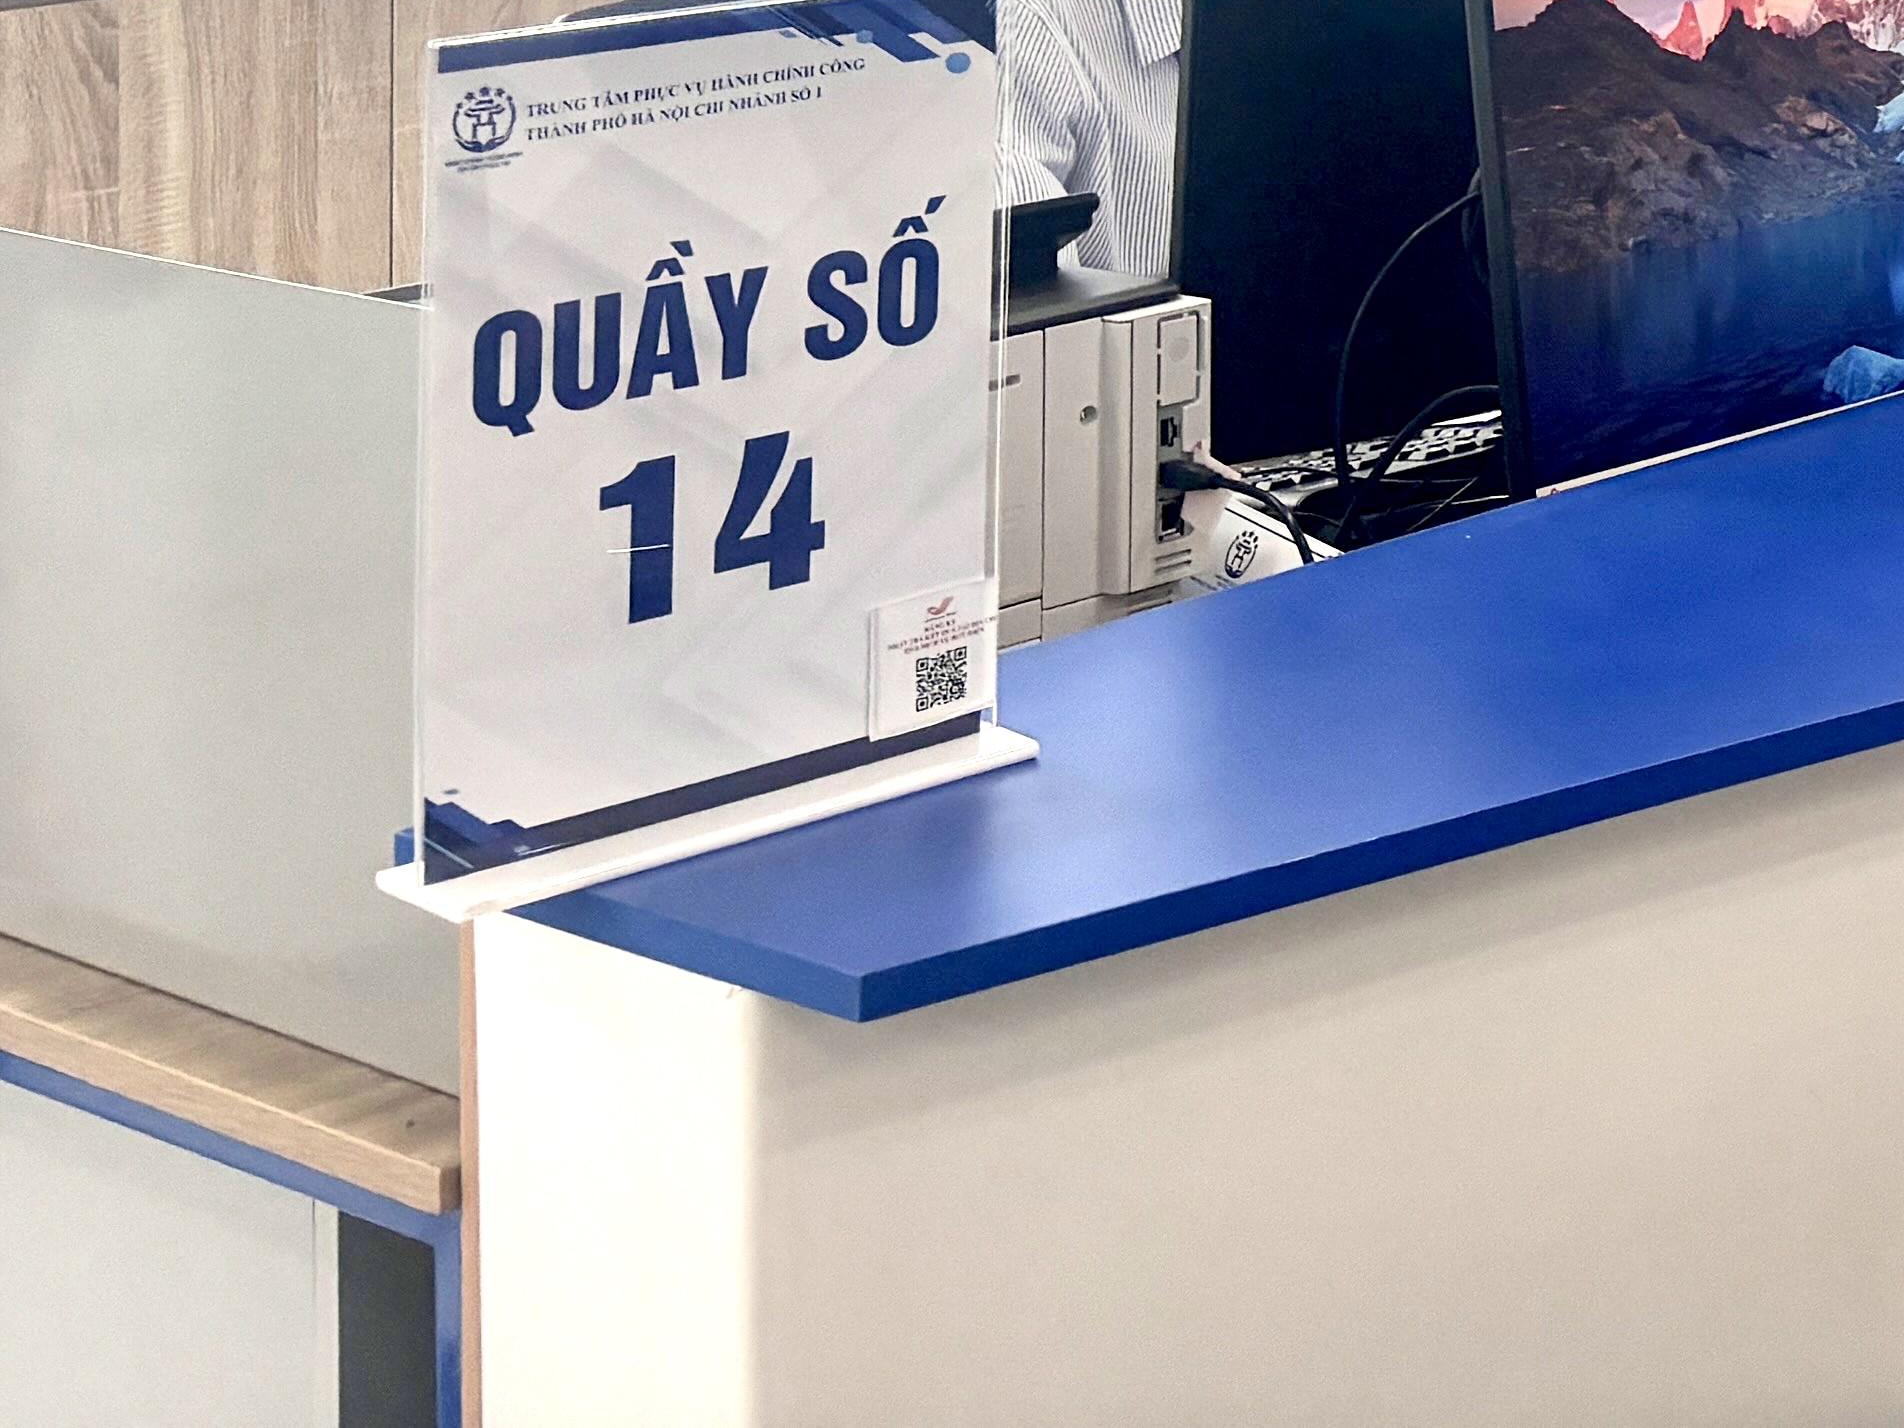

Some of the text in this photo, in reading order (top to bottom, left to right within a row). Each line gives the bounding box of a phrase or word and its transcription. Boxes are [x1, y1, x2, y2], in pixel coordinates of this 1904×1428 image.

[527, 97, 587, 117] TRUNG
[590, 90, 629, 109] TÂM
[819, 58, 866, 76] CÔNG
[471, 195, 946, 438] QUẦY SỐ
[599, 431, 826, 625] 14
